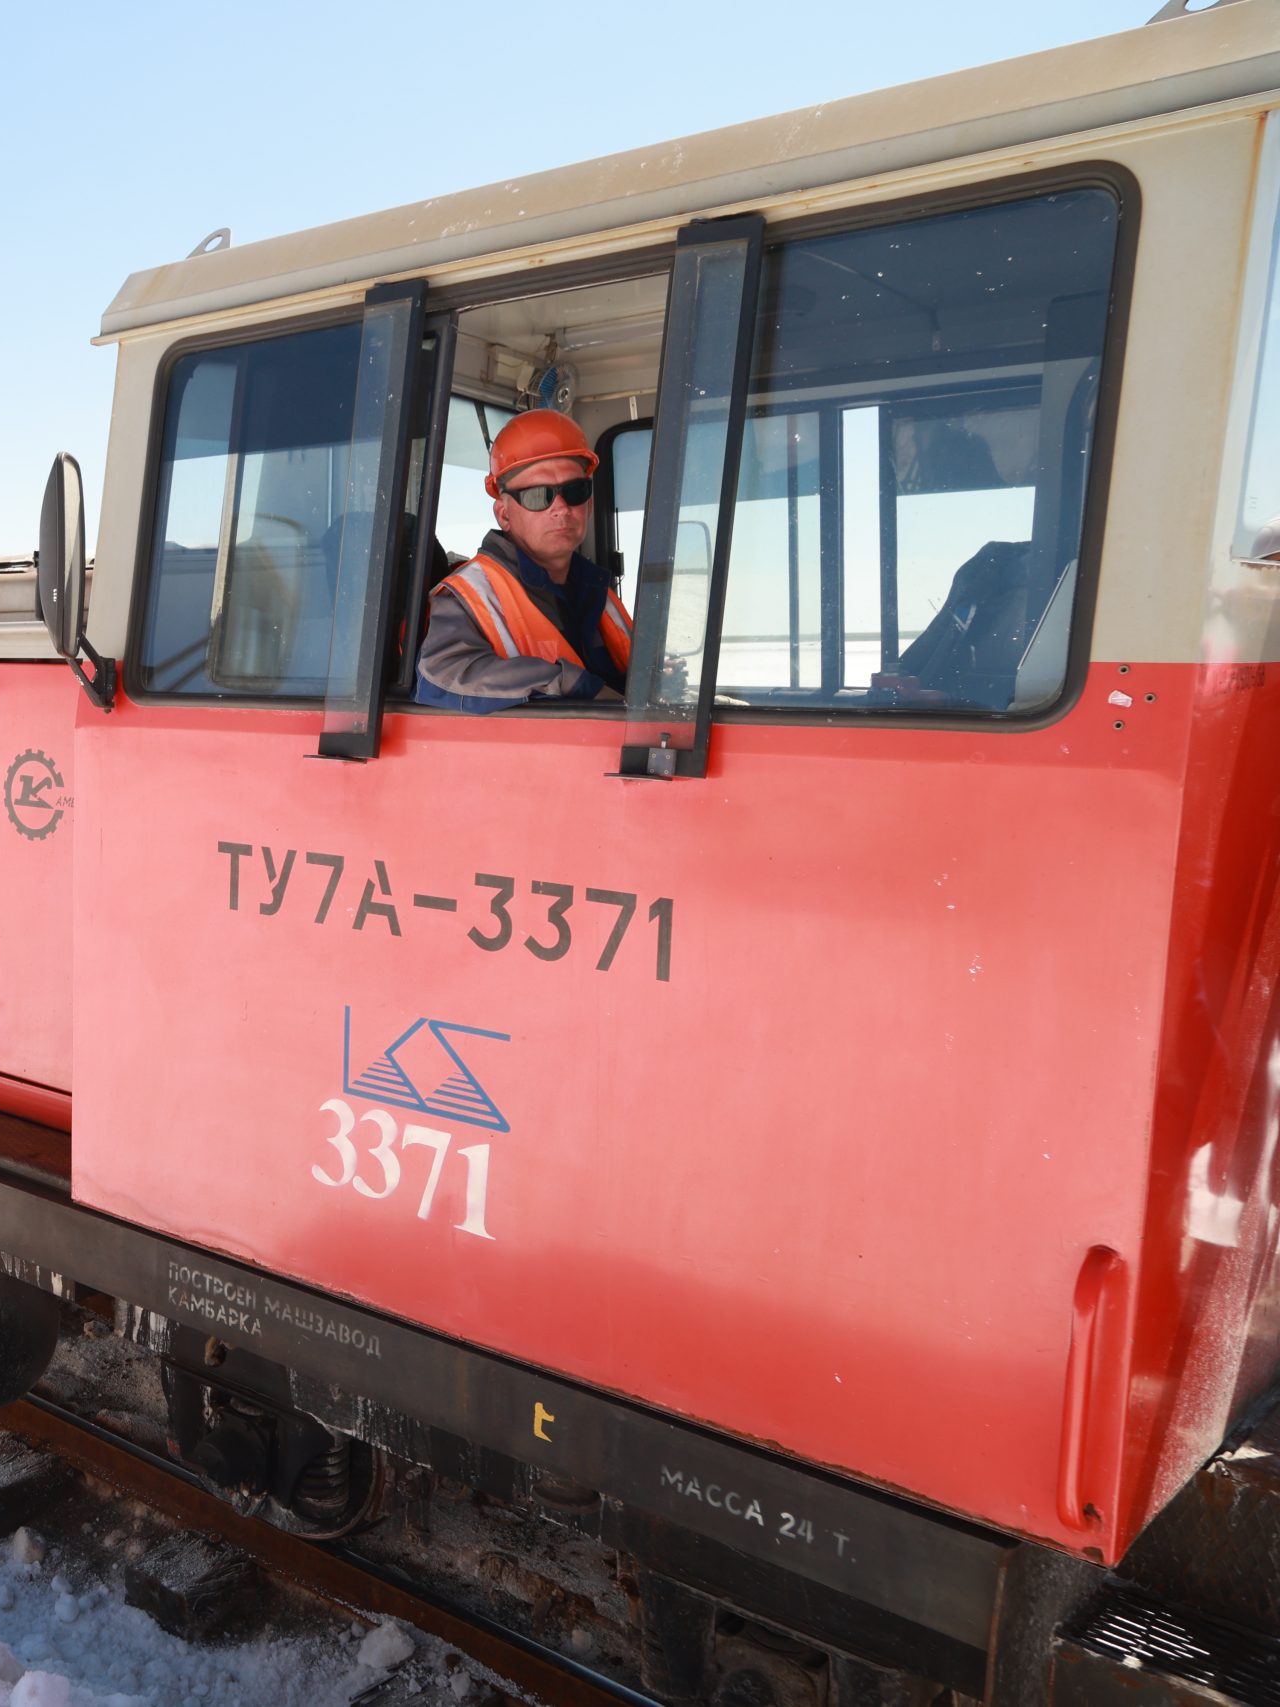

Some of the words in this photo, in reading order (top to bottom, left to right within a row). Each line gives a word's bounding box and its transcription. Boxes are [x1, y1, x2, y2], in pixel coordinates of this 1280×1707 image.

[217, 840, 674, 983] ТУ7А-3371
[311, 1098, 497, 1241] 3371
[168, 1261, 257, 1308] ПОСТРОЕН
[264, 1296, 382, 1359] МАШЗАВОД
[168, 1286, 262, 1337] КАМБАРКА
[660, 1464, 765, 1527] МАССА
[778, 1511, 815, 1545] 24
